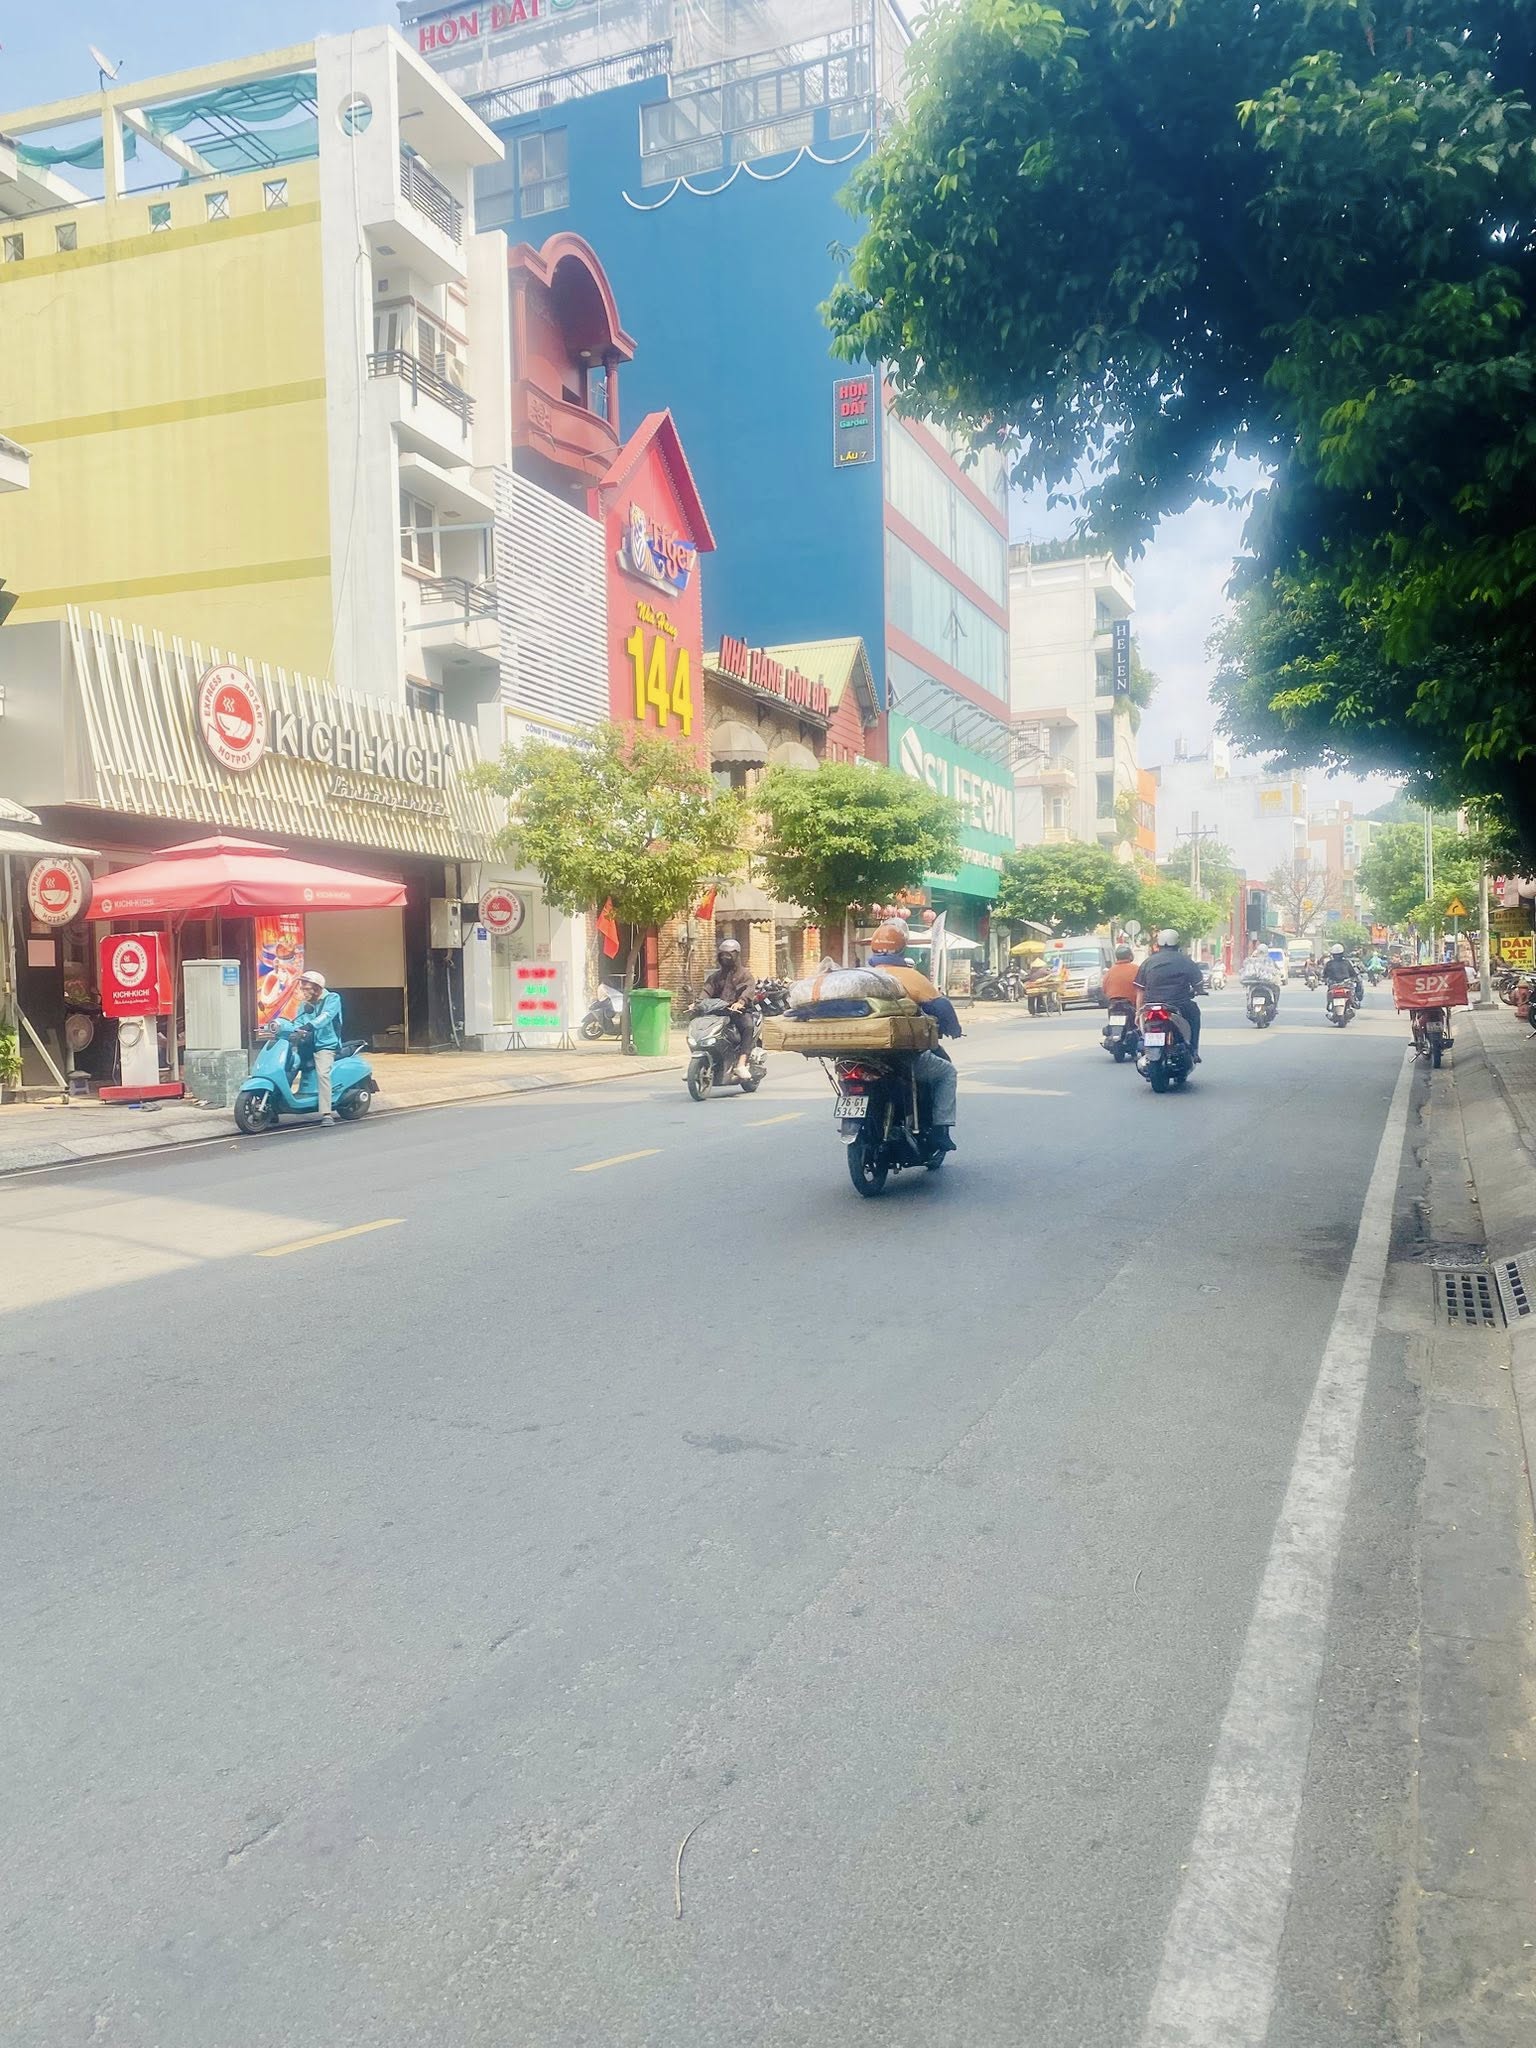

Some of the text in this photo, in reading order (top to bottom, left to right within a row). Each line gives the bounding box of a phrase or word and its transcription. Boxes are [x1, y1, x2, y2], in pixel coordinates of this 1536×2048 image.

[839, 418, 868, 429] Garden
[650, 519, 697, 578] Tiger
[719, 634, 749, 680] NHÀ
[750, 648, 786, 696] HÀNG
[1116, 625, 1126, 690] HELEN
[626, 626, 694, 737] 144
[204, 674, 264, 727] EXPRESS ROTARY
[217, 745, 252, 764] HOTPOT
[271, 709, 452, 790] KICHI-KICHI
[1508, 949, 1527, 959] XE
[112, 989, 150, 999] KICHI-KICHI
[1415, 975, 1449, 992] SPX
[841, 1097, 864, 1107] 76-G1
